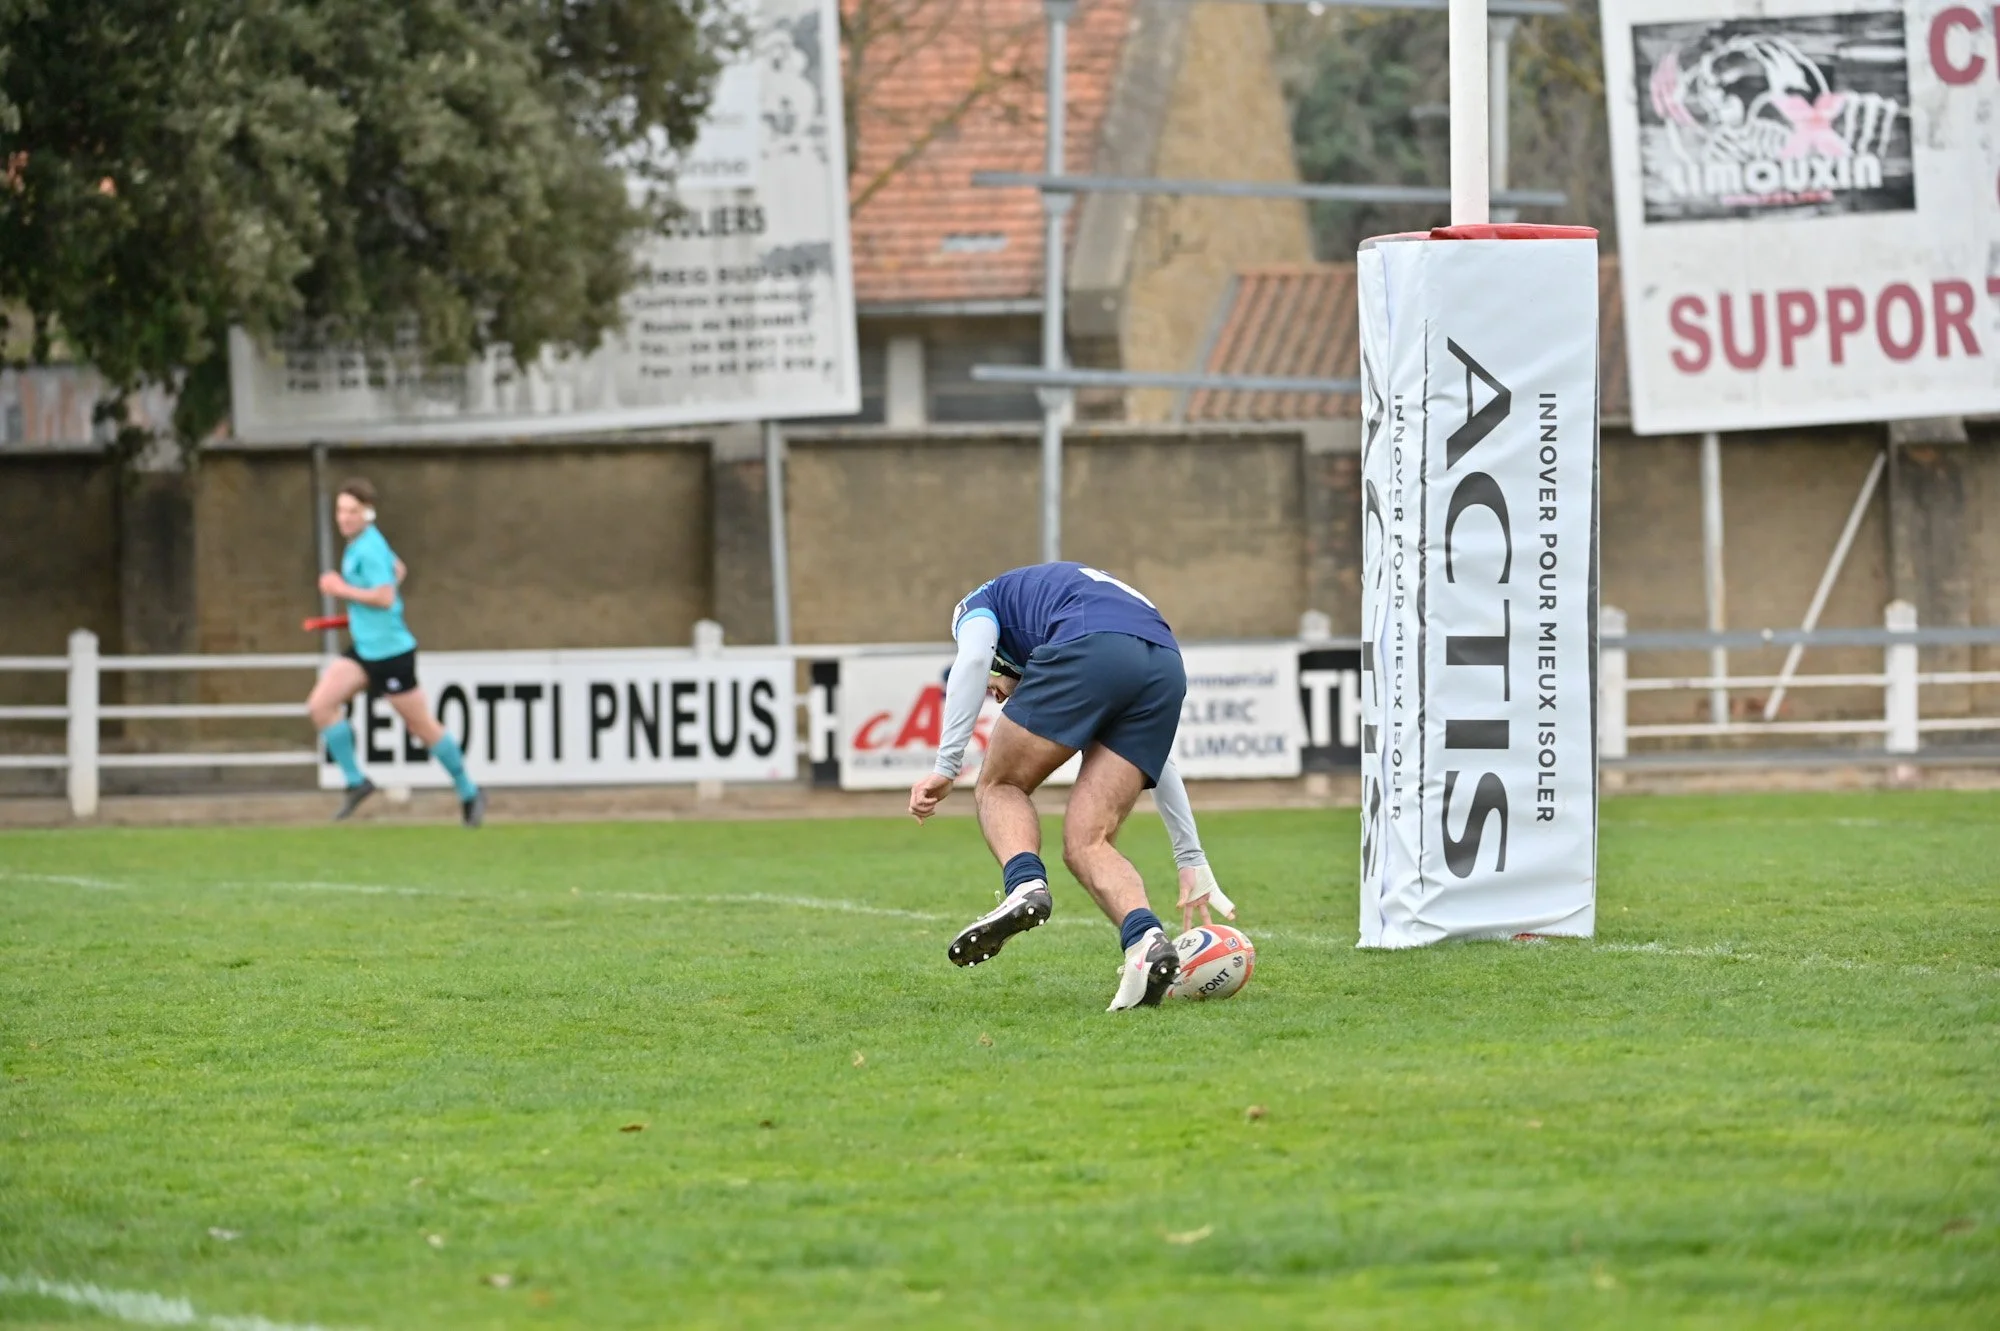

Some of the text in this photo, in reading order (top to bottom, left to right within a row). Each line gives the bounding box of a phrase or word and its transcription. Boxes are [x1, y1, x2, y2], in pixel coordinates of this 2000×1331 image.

[1929, 5, 2000, 86] C
[590, 679, 778, 761] PNEUS
[1391, 394, 1405, 821] INNOVER POUR MIEUX ISOLER
[1443, 336, 1513, 880] ACTIS
[1536, 393, 1558, 822] INNOVER POUR MIEUX ISOLER
